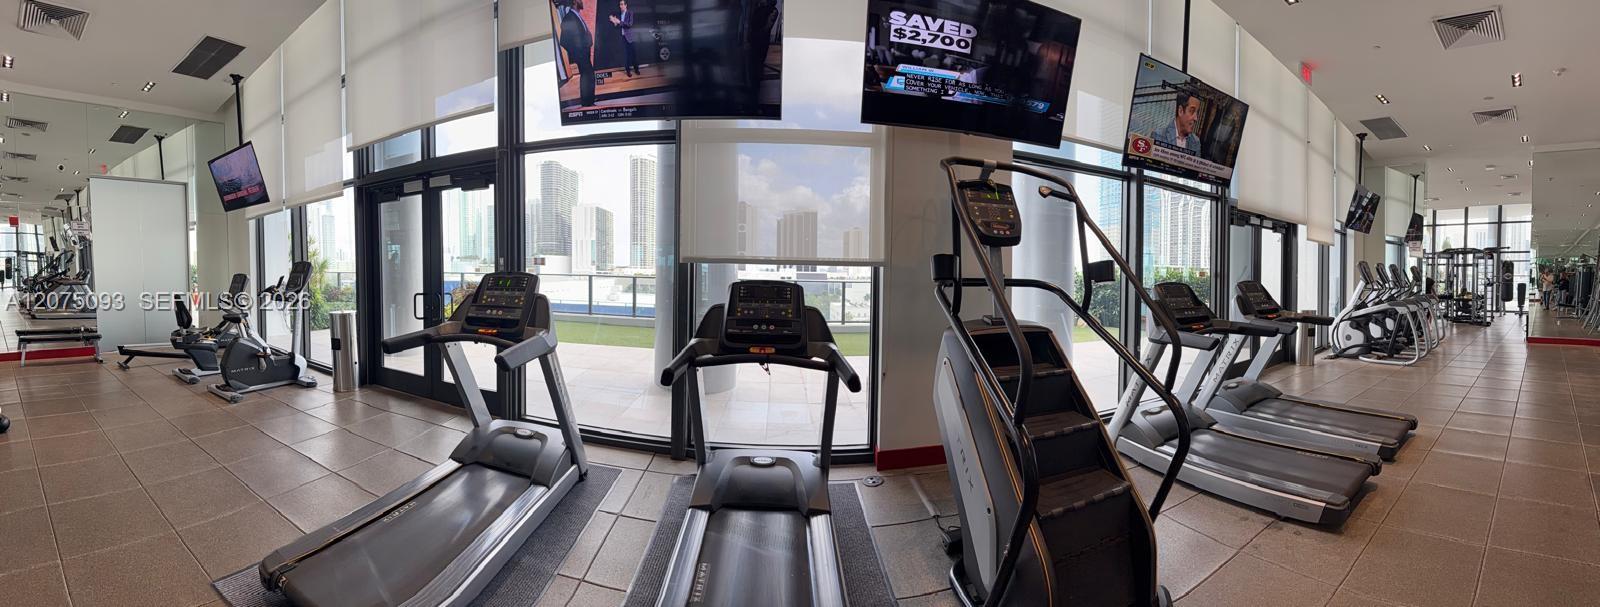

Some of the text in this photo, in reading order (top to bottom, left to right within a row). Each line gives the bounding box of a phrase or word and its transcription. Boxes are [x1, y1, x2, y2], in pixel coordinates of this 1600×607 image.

[888, 10, 978, 38] SAVED
[892, 27, 970, 50] $2,700
[905, 78, 925, 87] COVER
[927, 81, 942, 89] YOUR
[906, 73, 925, 81] NEVER
[927, 76, 943, 84] RISE
[944, 78, 956, 86] FOR
[905, 85, 938, 94] SOMETHING
[1213, 337, 1240, 384] MATRIX
